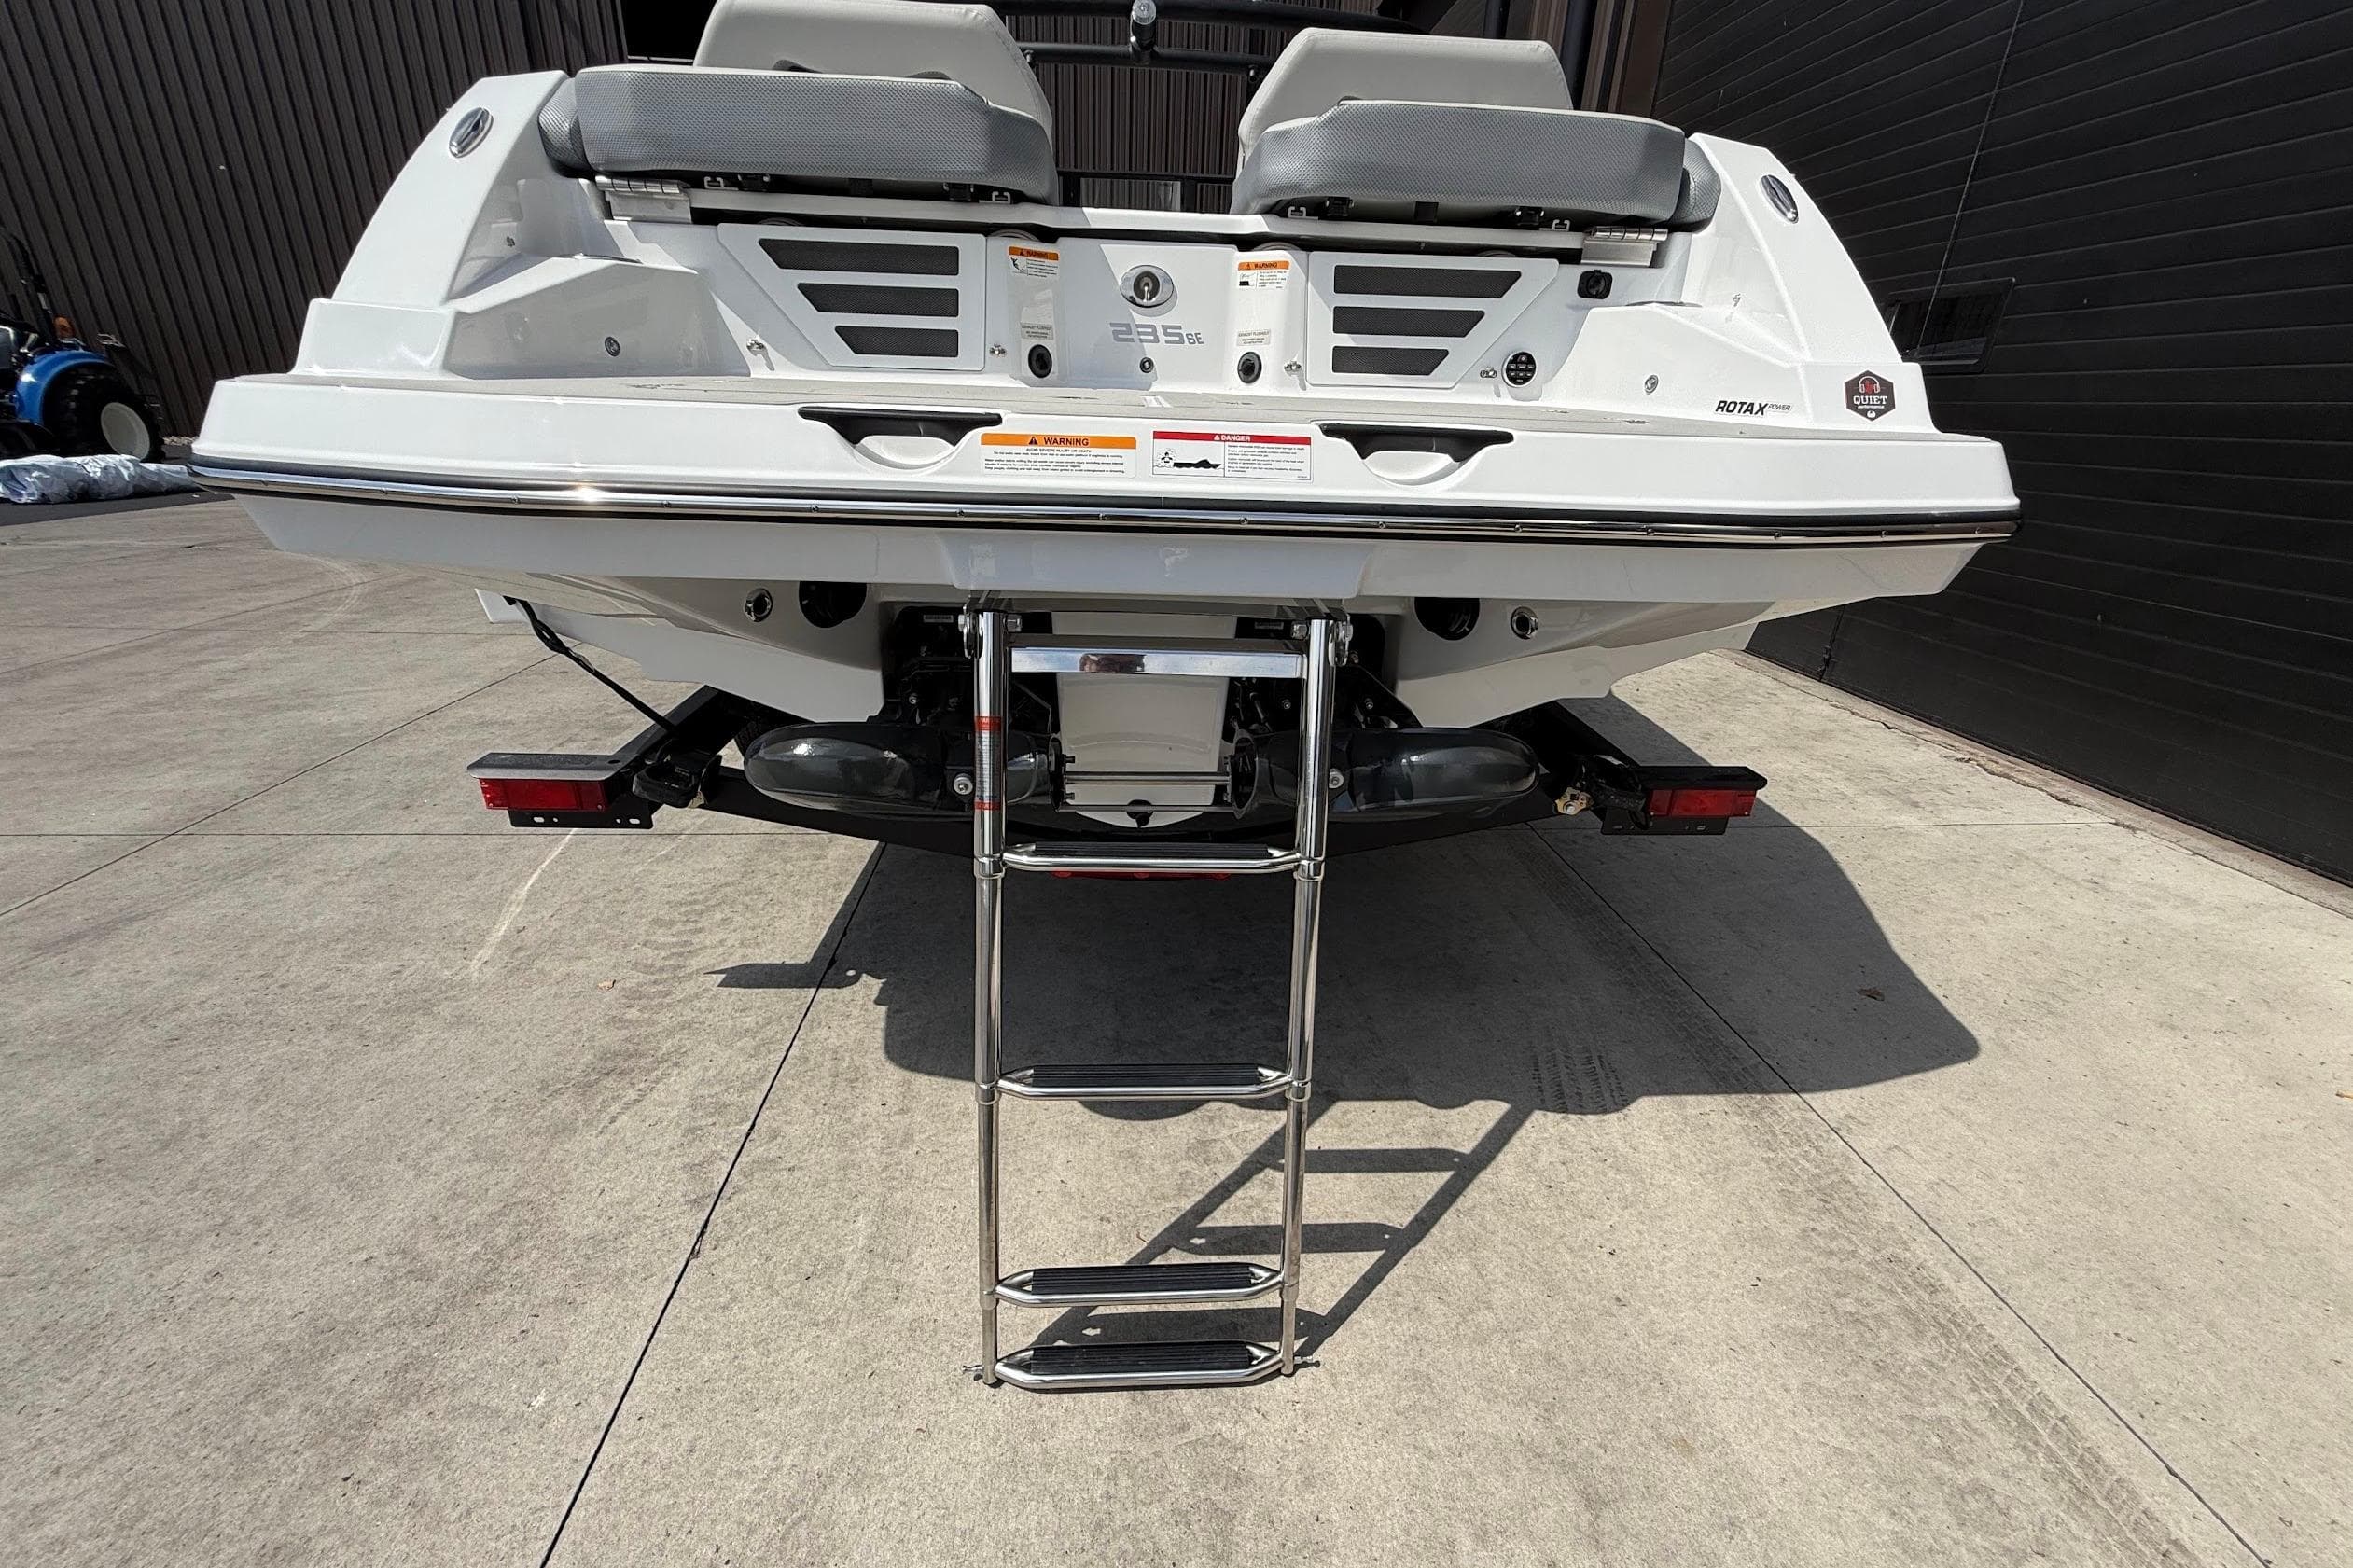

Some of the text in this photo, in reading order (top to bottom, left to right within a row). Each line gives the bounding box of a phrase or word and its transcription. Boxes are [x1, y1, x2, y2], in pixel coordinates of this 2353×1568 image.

[1109, 322, 1204, 345] 235 SE
[1853, 395, 1887, 405] QUIET
[1715, 399, 1791, 416] ROTAX POWER
[1043, 436, 1090, 447] WARNING
